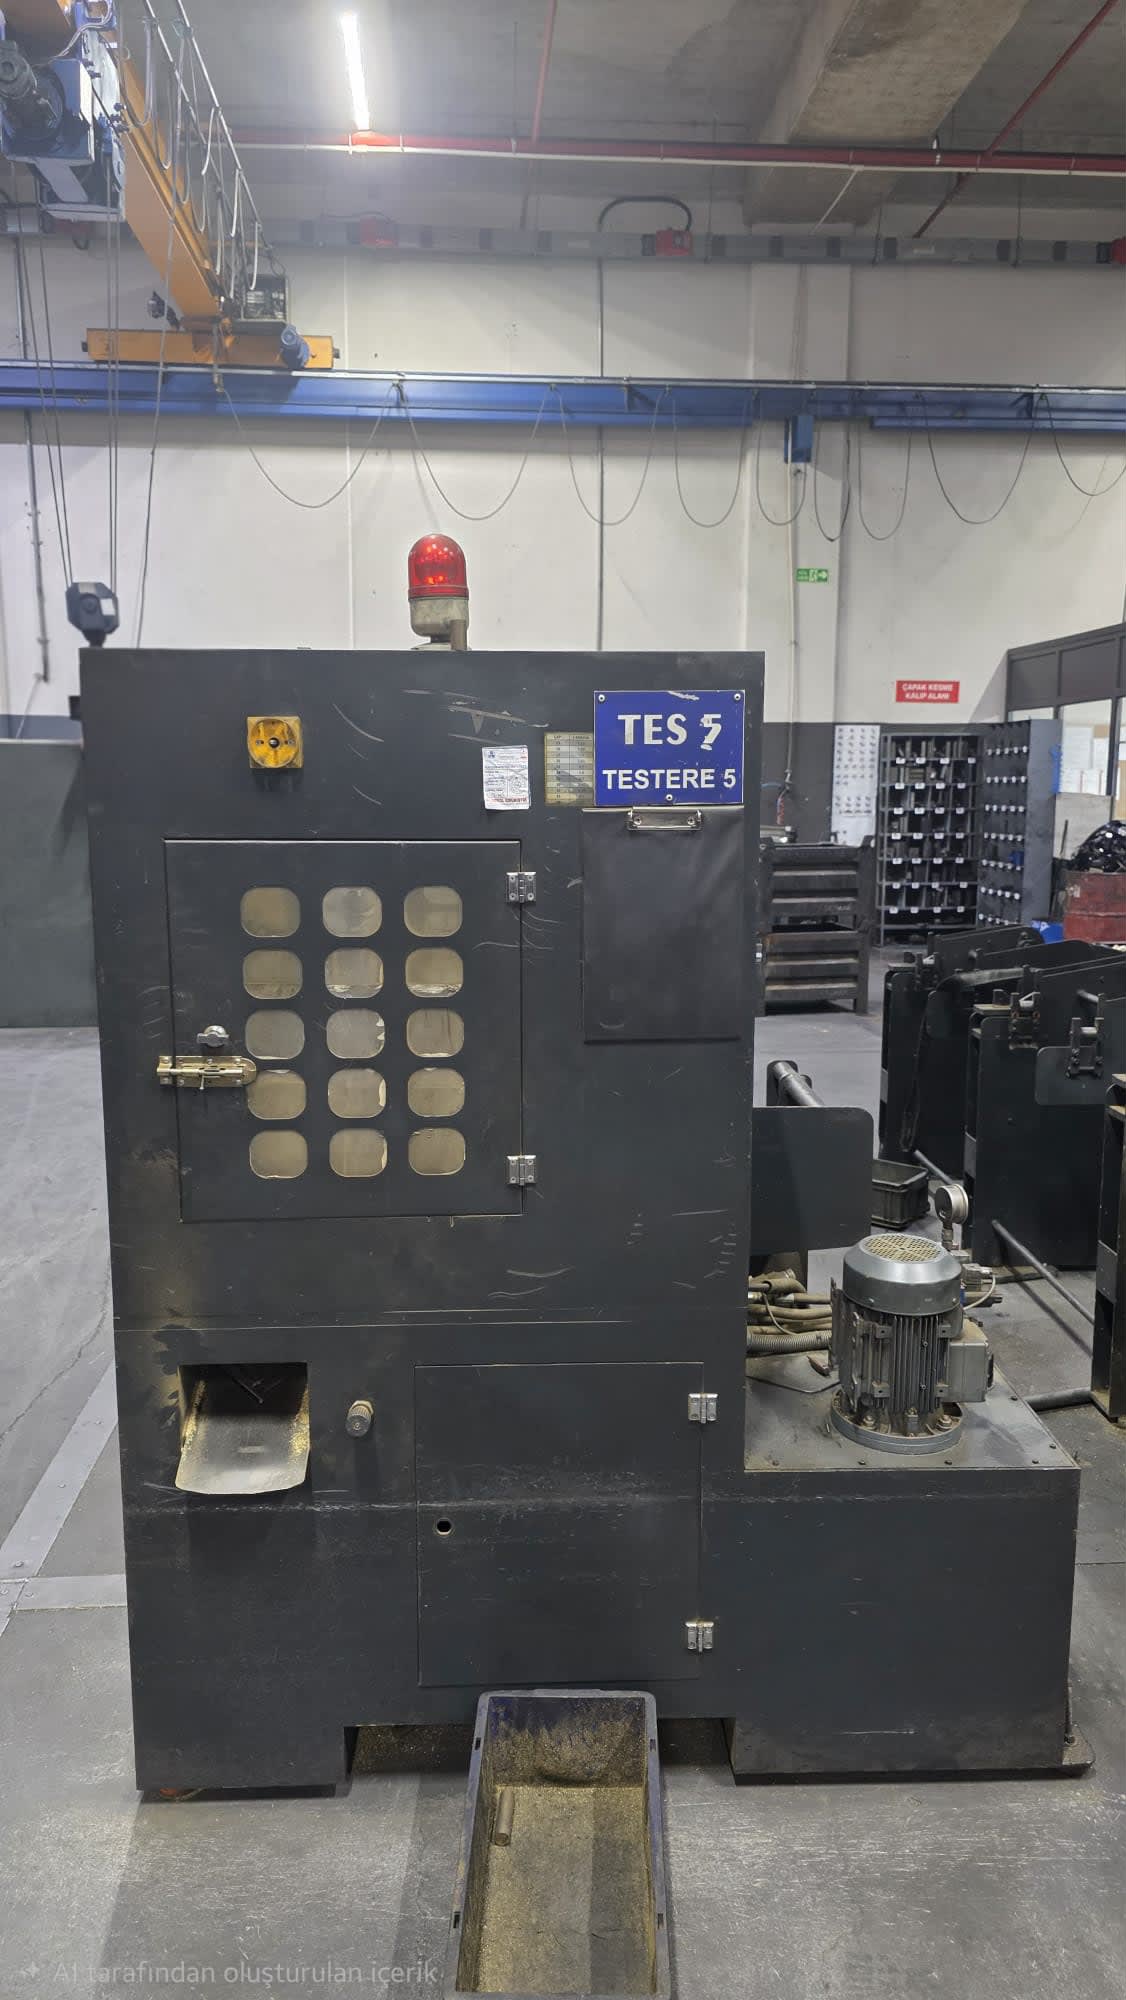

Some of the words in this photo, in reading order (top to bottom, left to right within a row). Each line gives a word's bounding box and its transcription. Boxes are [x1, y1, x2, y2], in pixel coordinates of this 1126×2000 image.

[617, 713, 688, 745] TES
[602, 768, 716, 790] TESTERE
[723, 768, 737, 788] 5
